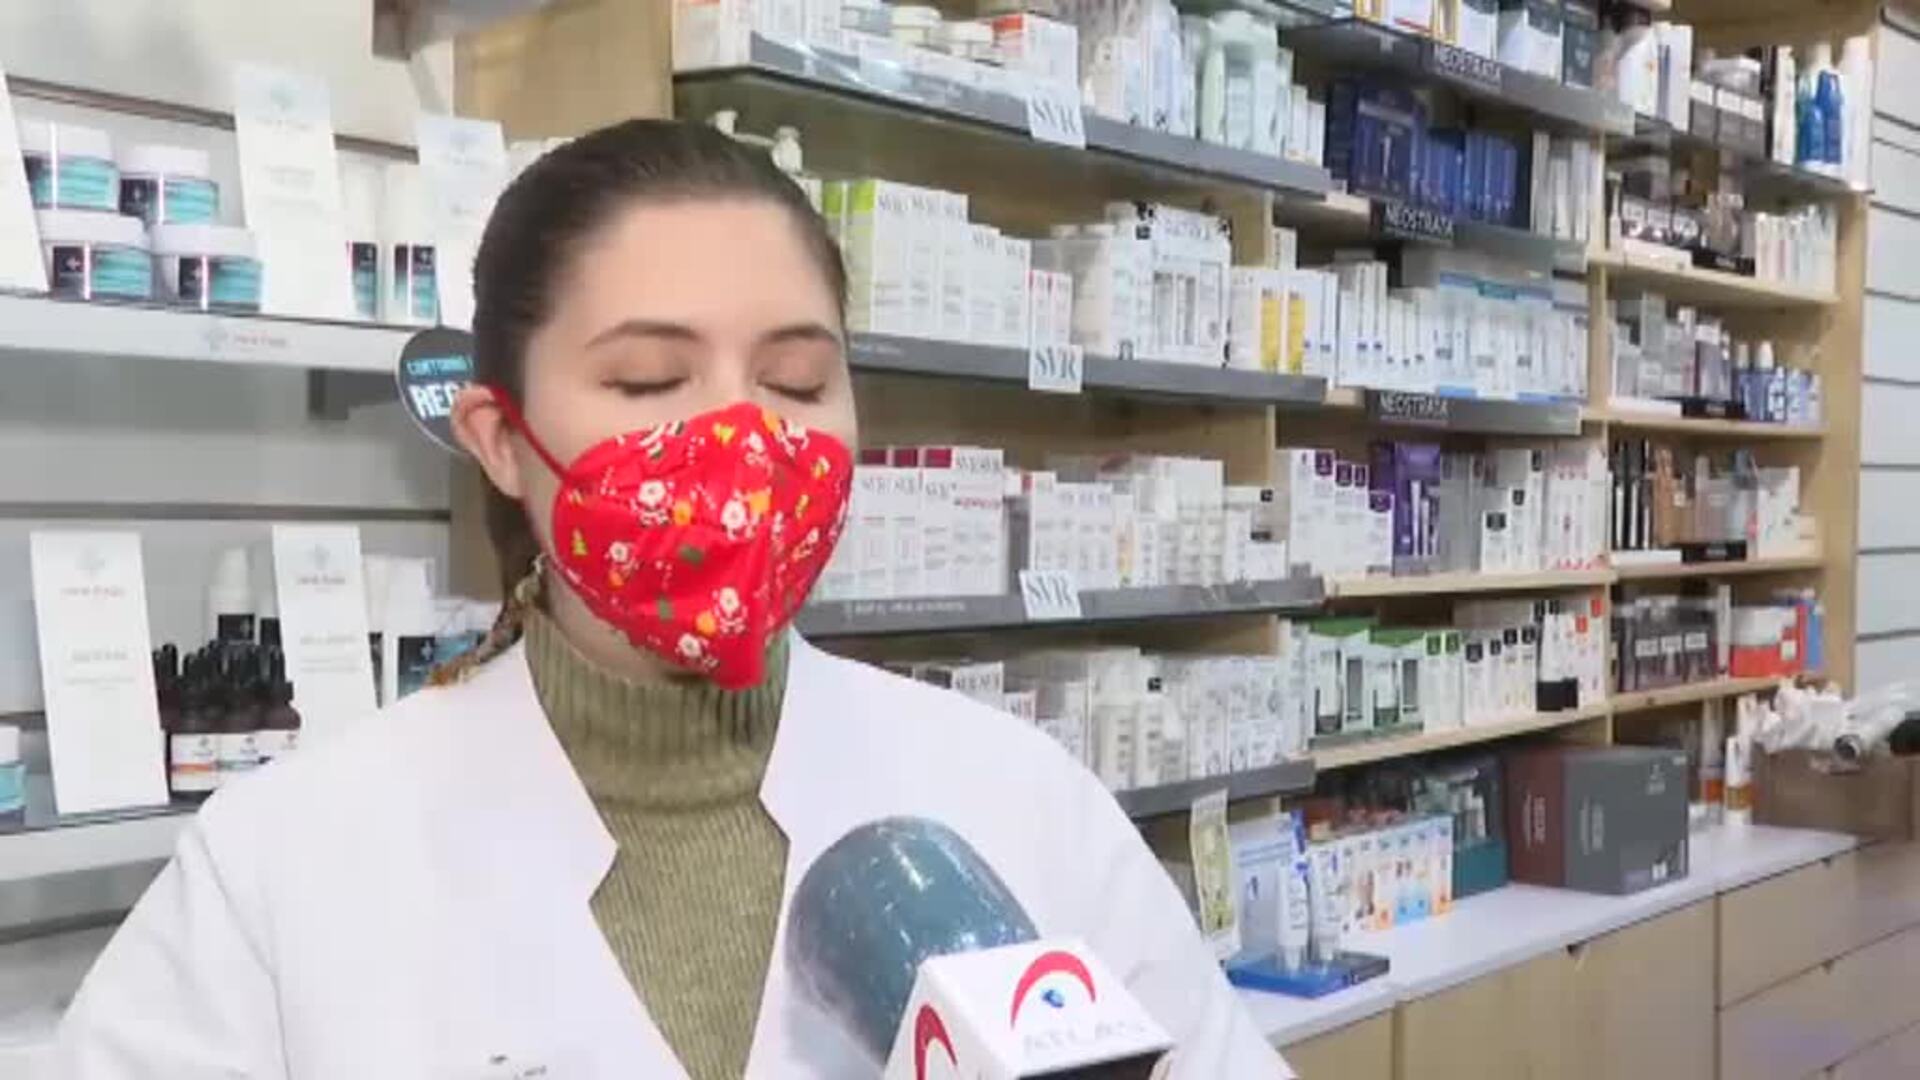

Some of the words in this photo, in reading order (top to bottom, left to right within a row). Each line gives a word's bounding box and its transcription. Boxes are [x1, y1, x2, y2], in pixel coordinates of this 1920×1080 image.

[1032, 97, 1077, 134] SVR
[1384, 199, 1455, 239] NEOSTRATA
[1034, 346, 1077, 380] SVR
[1380, 388, 1448, 416] NEOSTRATA
[1025, 575, 1073, 608] SVR
